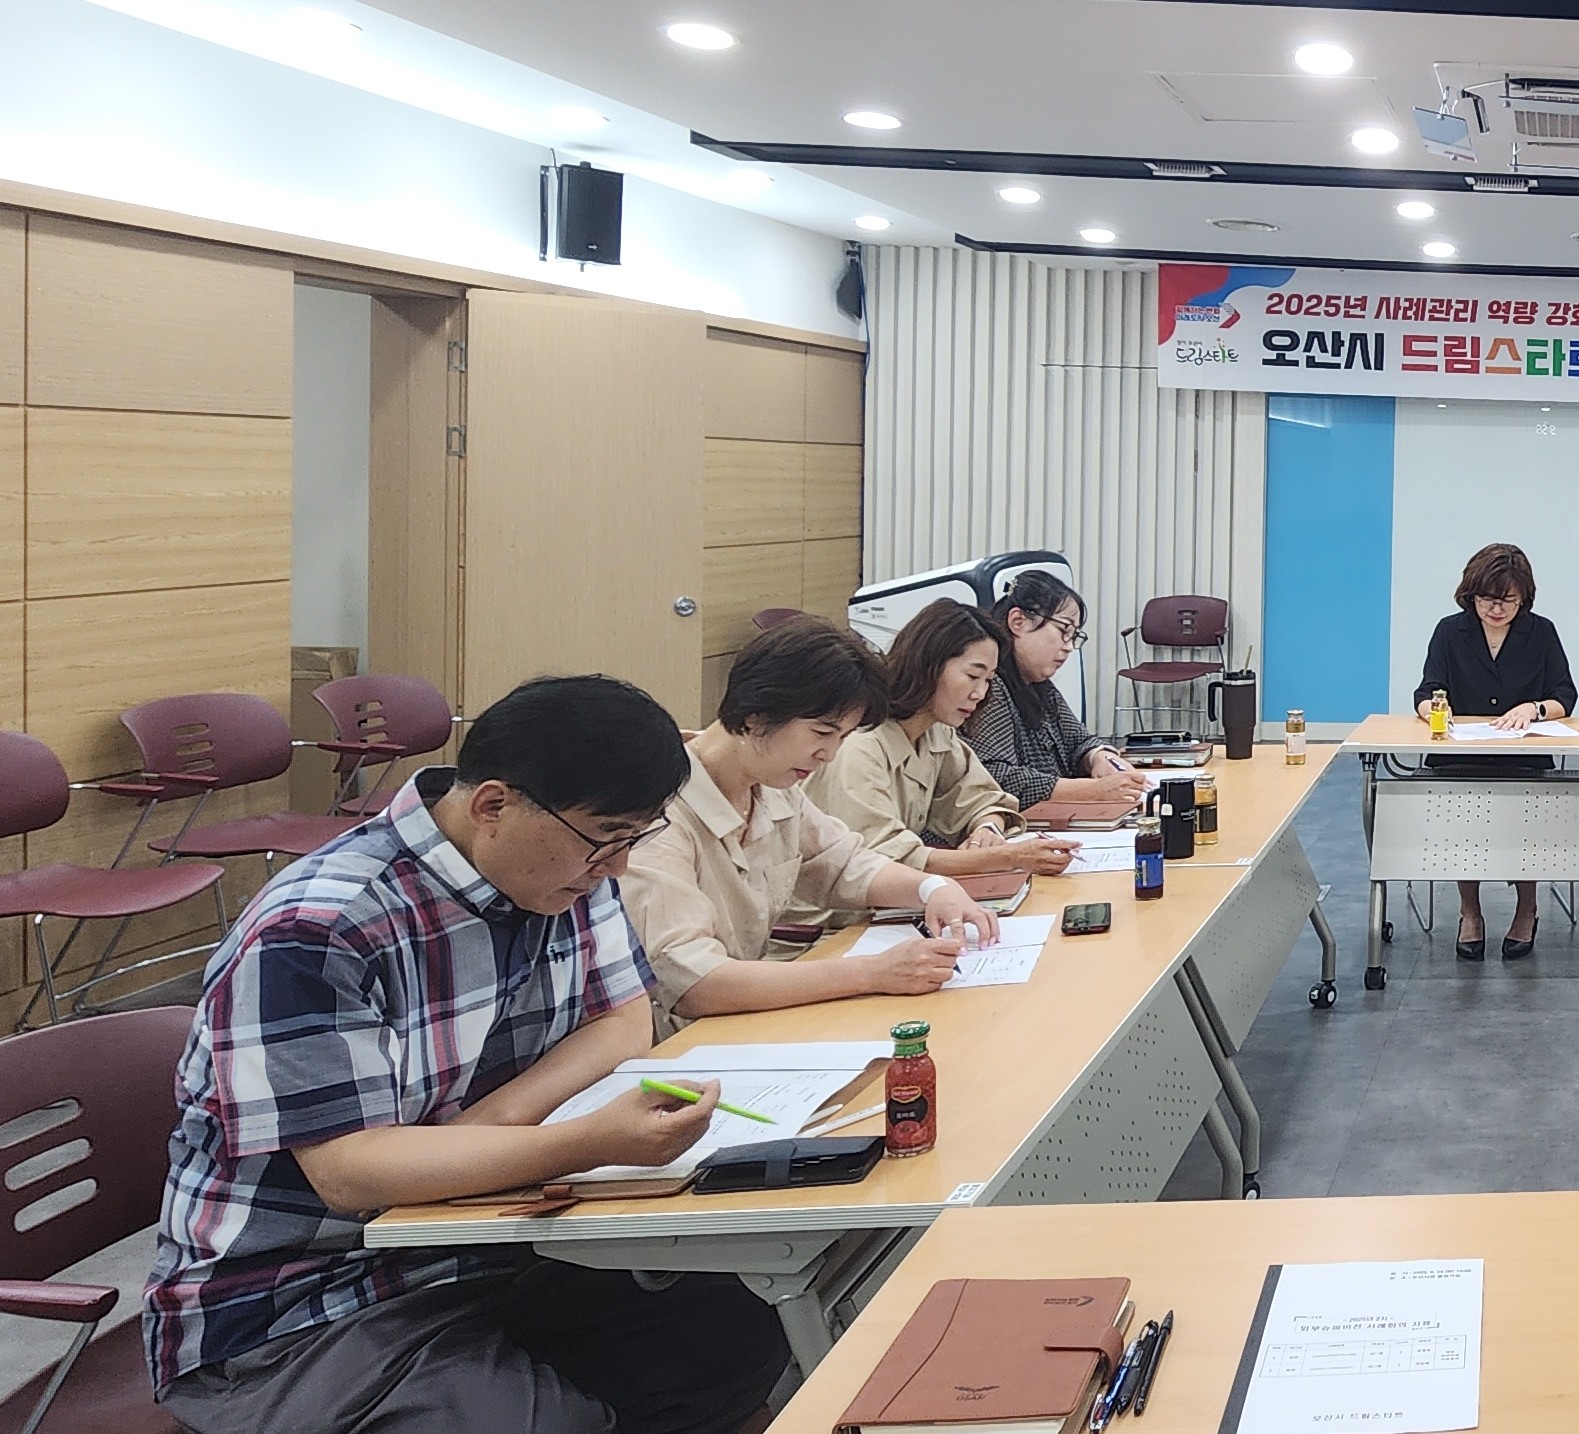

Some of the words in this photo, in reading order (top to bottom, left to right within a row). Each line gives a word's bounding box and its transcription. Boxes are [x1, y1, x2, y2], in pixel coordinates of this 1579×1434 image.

[1265, 292, 1368, 320] 2025년
[1373, 296, 1479, 324] 사례관리
[1487, 300, 1538, 326] 역량
[1176, 343, 1239, 366] 드림스타트
[1261, 328, 1385, 372] 오산시
